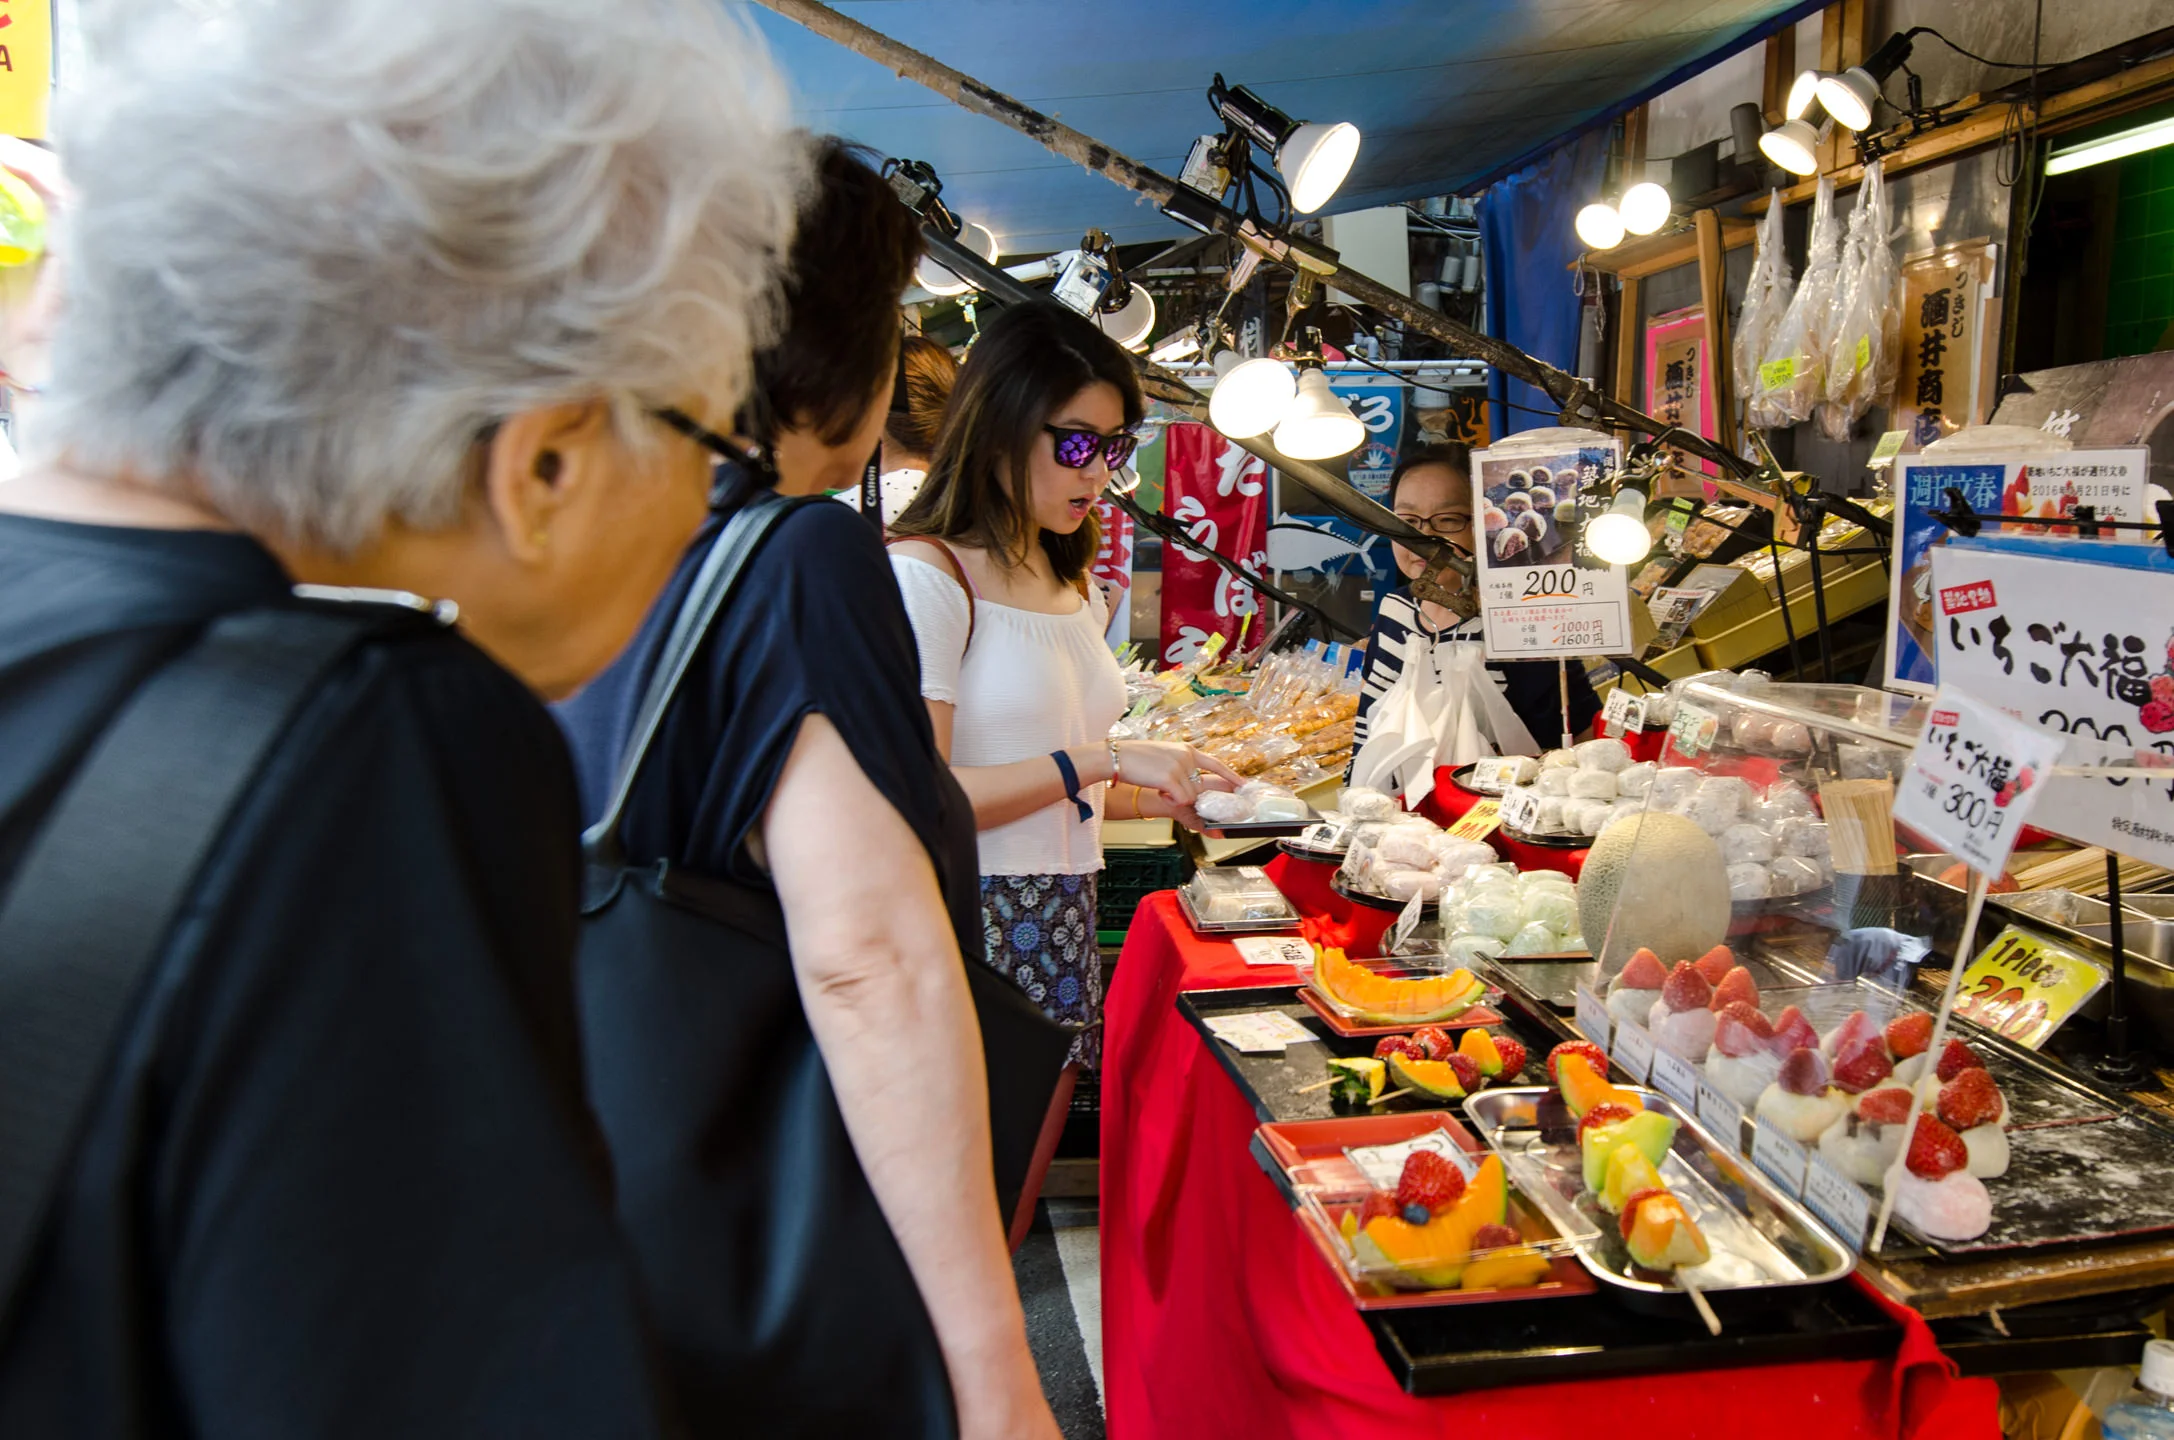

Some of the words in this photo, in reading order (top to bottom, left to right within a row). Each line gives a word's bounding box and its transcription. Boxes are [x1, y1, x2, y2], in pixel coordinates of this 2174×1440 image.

[1951, 271, 1968, 338] つきじ
[866, 465, 877, 507] Canon
[1950, 614, 2154, 707] いちご大福
